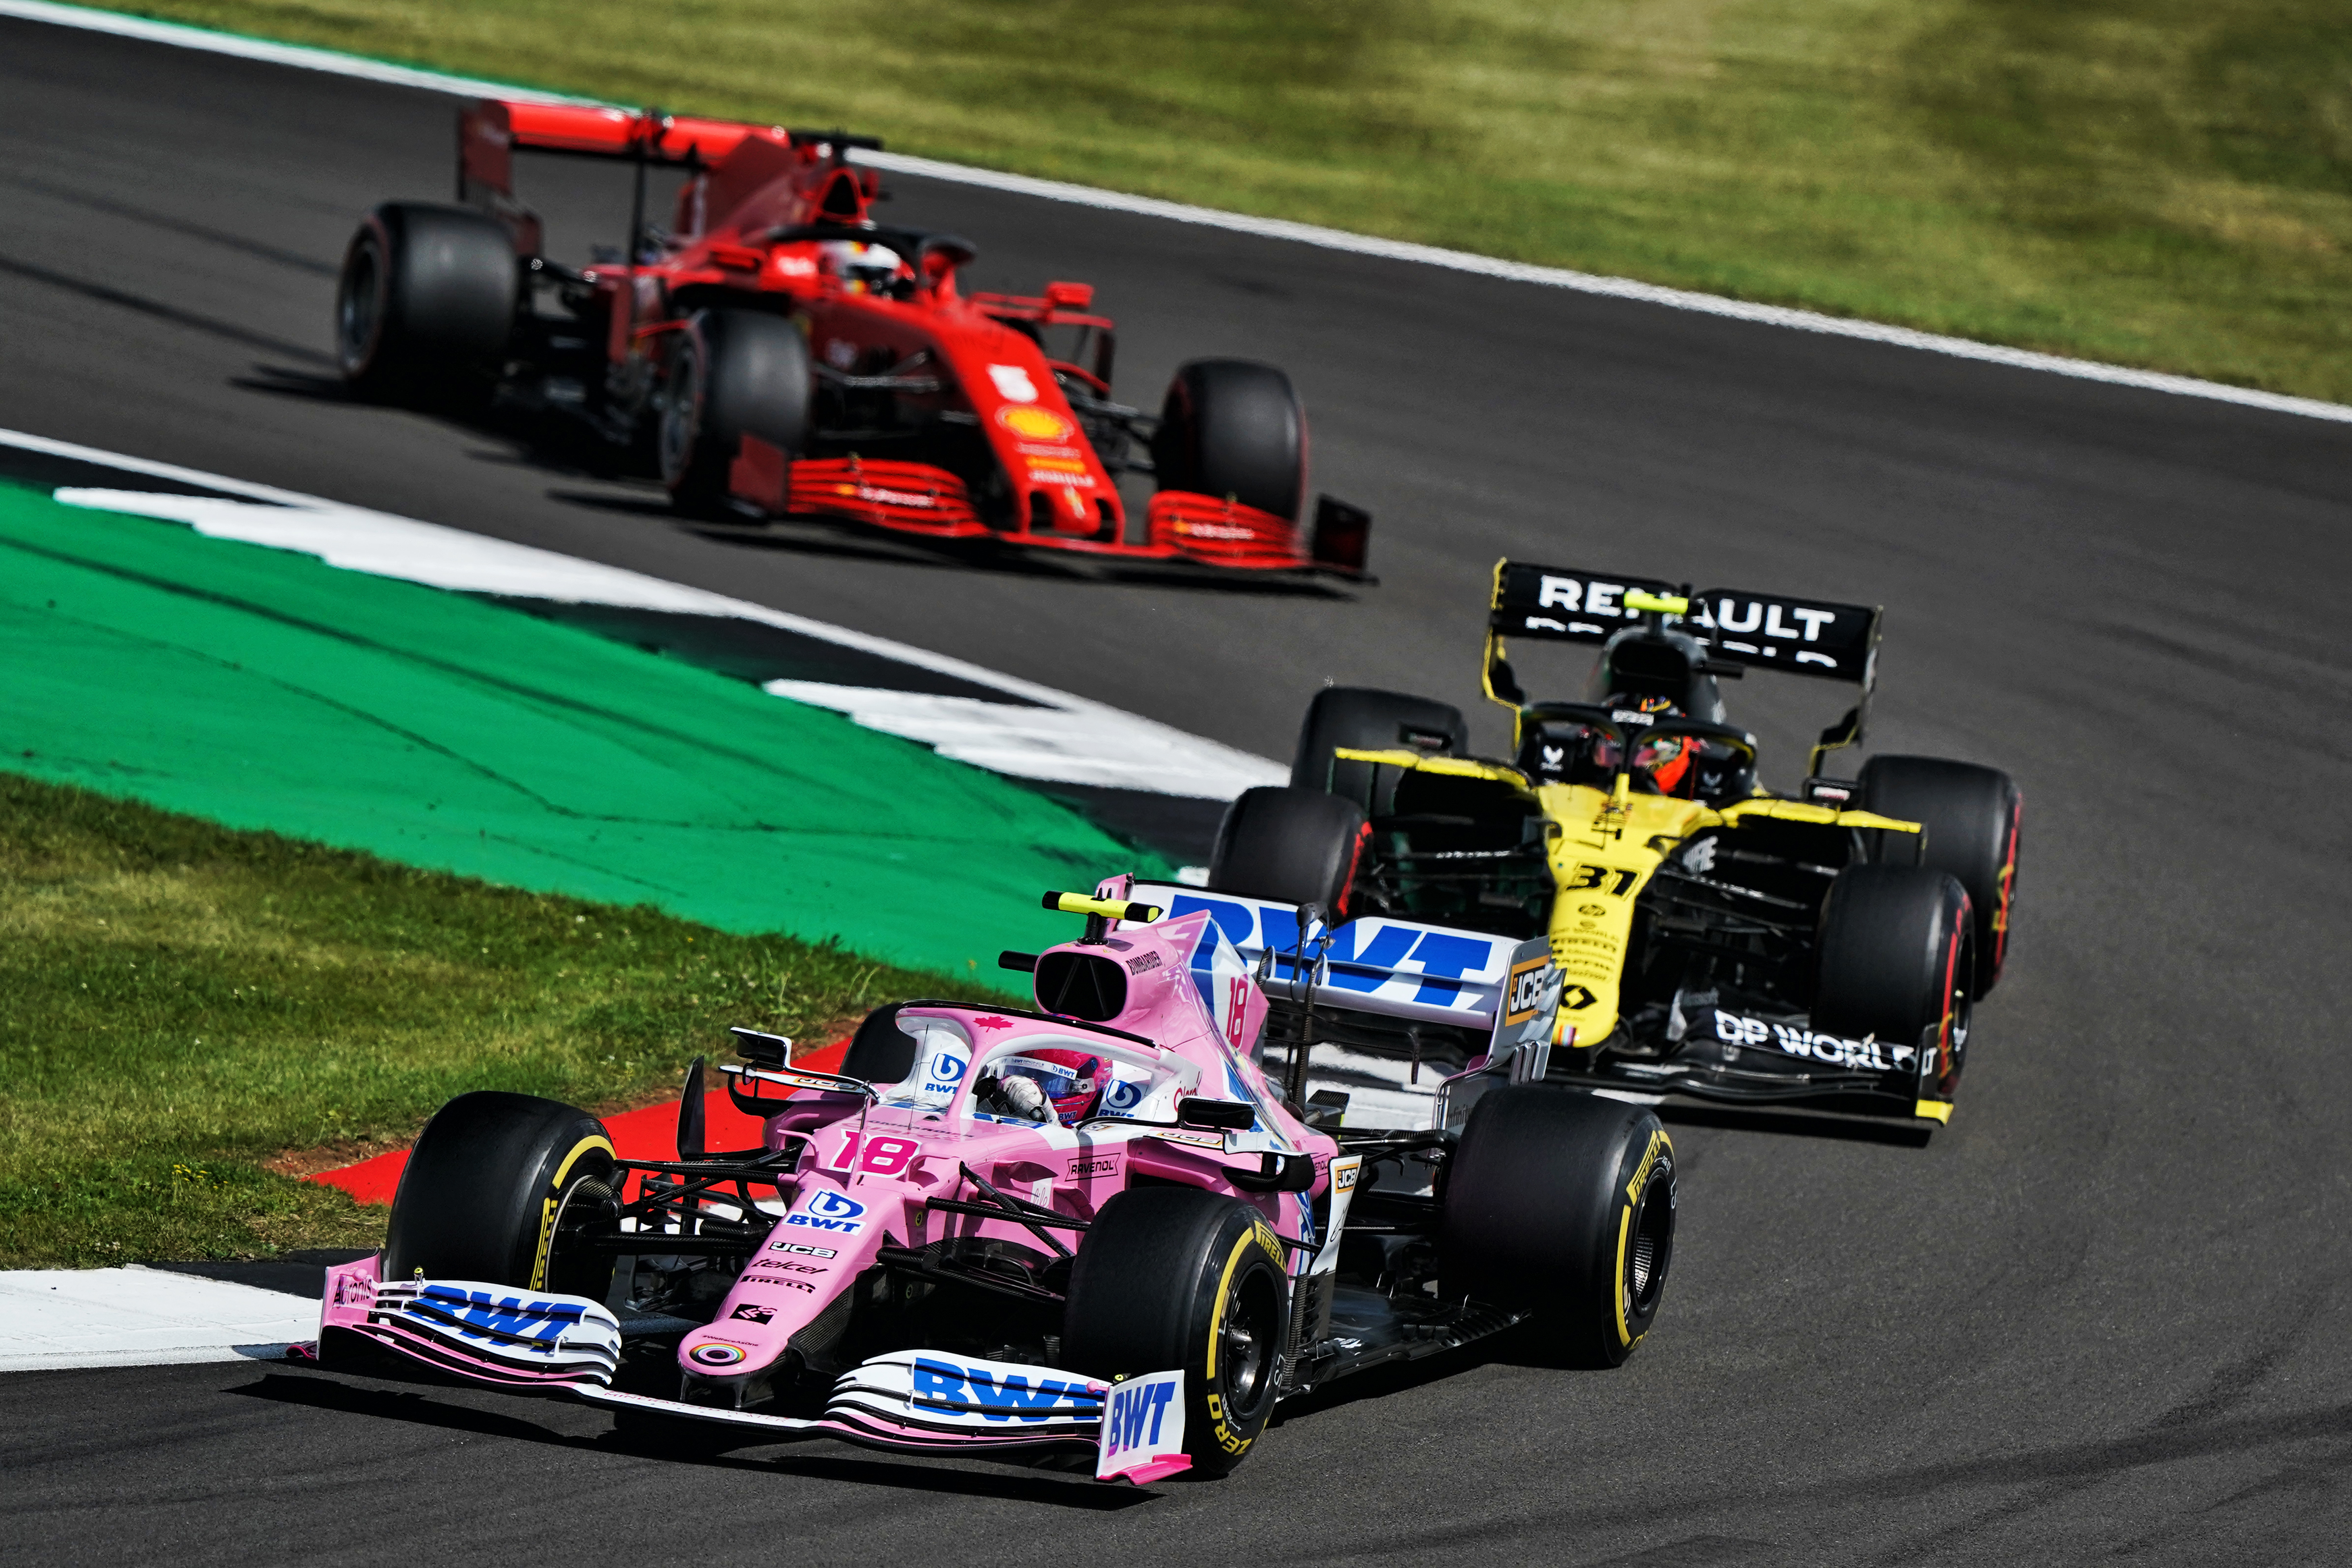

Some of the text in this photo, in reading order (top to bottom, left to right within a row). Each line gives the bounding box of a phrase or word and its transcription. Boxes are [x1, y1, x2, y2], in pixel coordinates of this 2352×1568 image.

[1567, 864, 1639, 898] 31
[1510, 969, 1545, 1012] JCB
[1226, 974, 1249, 1048] 18
[1714, 1009, 1769, 1046] DP
[1058, 1069, 1075, 1078] BWT
[925, 1083, 958, 1094] BWT
[1058, 1111, 1077, 1121] BWT
[1161, 1132, 1221, 1144] JCB
[829, 1129, 921, 1177] 18
[1071, 1160, 1114, 1175] RAVENOL
[1338, 1169, 1357, 1188] JCB
[786, 1215, 861, 1233] BWT
[771, 1242, 835, 1258] JCB
[751, 1258, 829, 1274] telcel
[332, 1279, 372, 1306] Acronis
[740, 1275, 816, 1294] PIRELLI
[403, 1285, 587, 1355] BWT
[737, 1306, 778, 1319] IFS
[702, 1335, 759, 1347] #WeRaceAsOne
[913, 1357, 1104, 1422] BWT
[1107, 1381, 1175, 1457] BWT
[1208, 1394, 1252, 1456] ZERO
